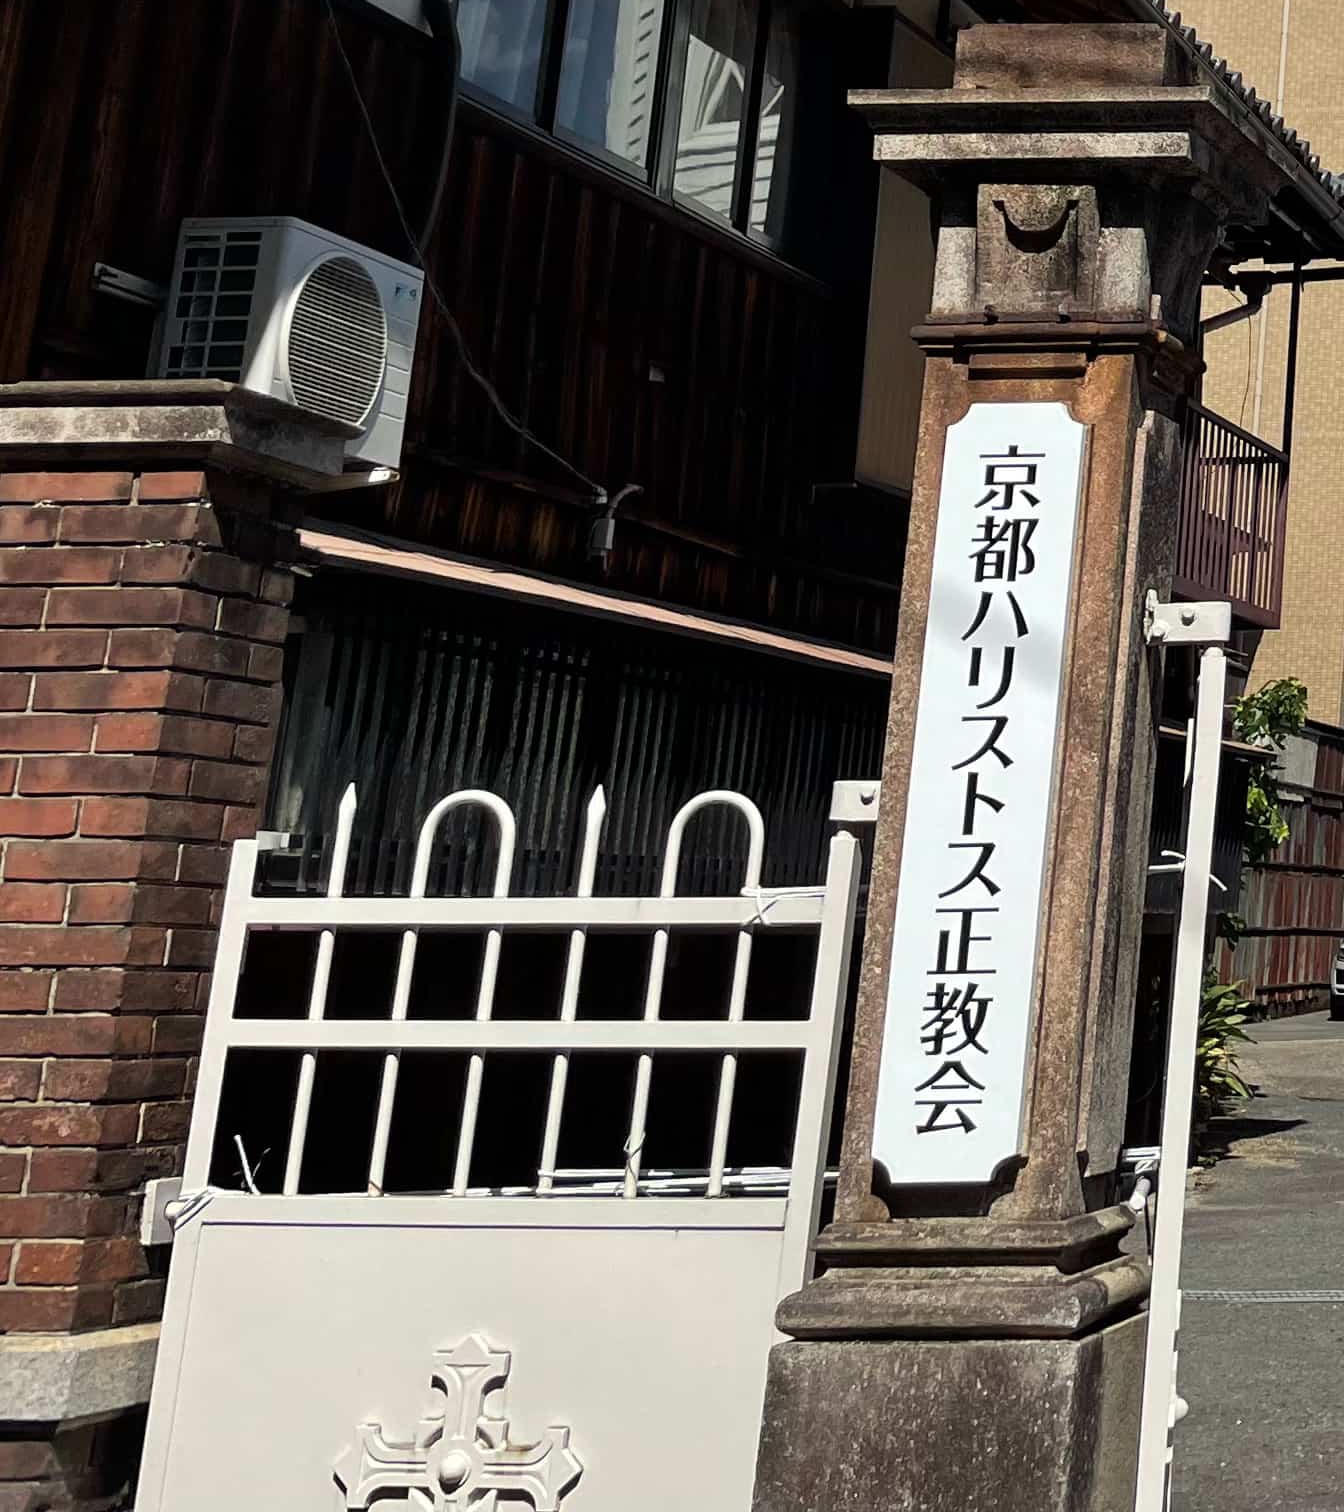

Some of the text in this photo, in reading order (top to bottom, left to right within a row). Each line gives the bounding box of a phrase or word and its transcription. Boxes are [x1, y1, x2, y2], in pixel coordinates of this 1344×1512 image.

[915, 444, 1046, 1135] 京都ハリストス正教会
